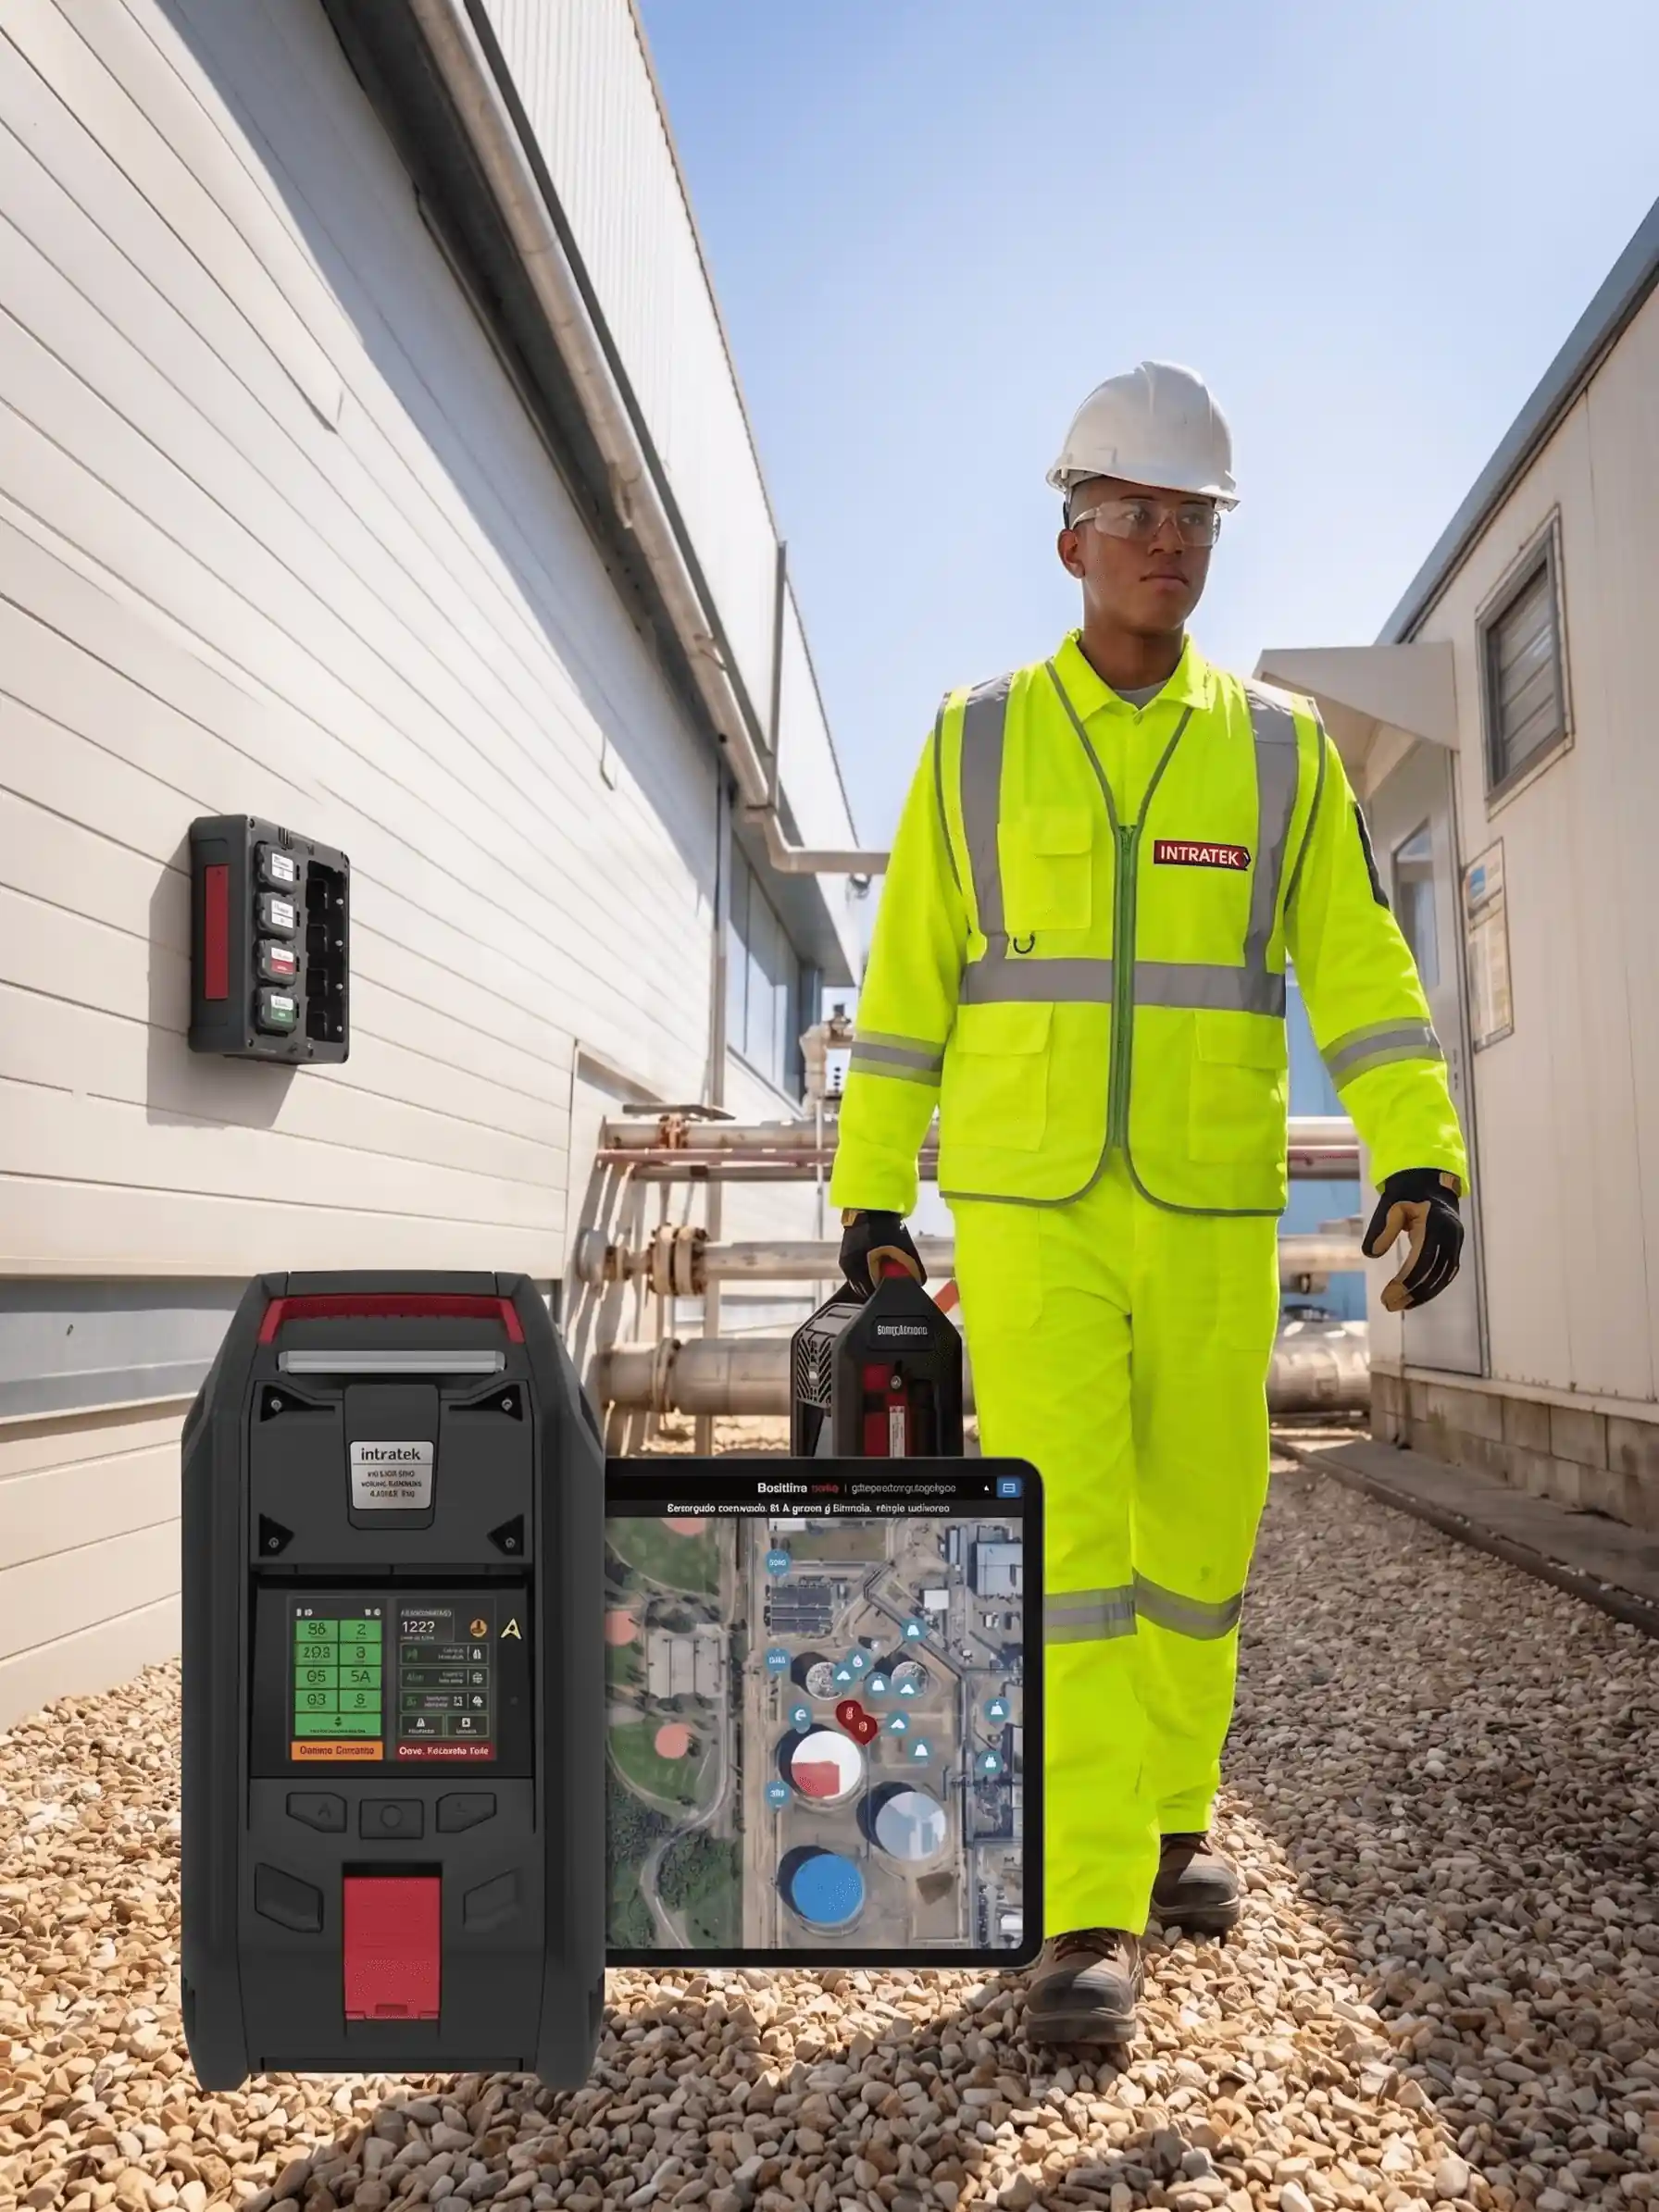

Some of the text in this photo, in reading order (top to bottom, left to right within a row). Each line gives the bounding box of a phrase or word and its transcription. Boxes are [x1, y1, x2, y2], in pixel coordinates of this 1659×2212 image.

[1160, 845, 1241, 866] INTRATEK
[360, 1448, 421, 1460] intratek
[351, 1670, 371, 1683] 5A
